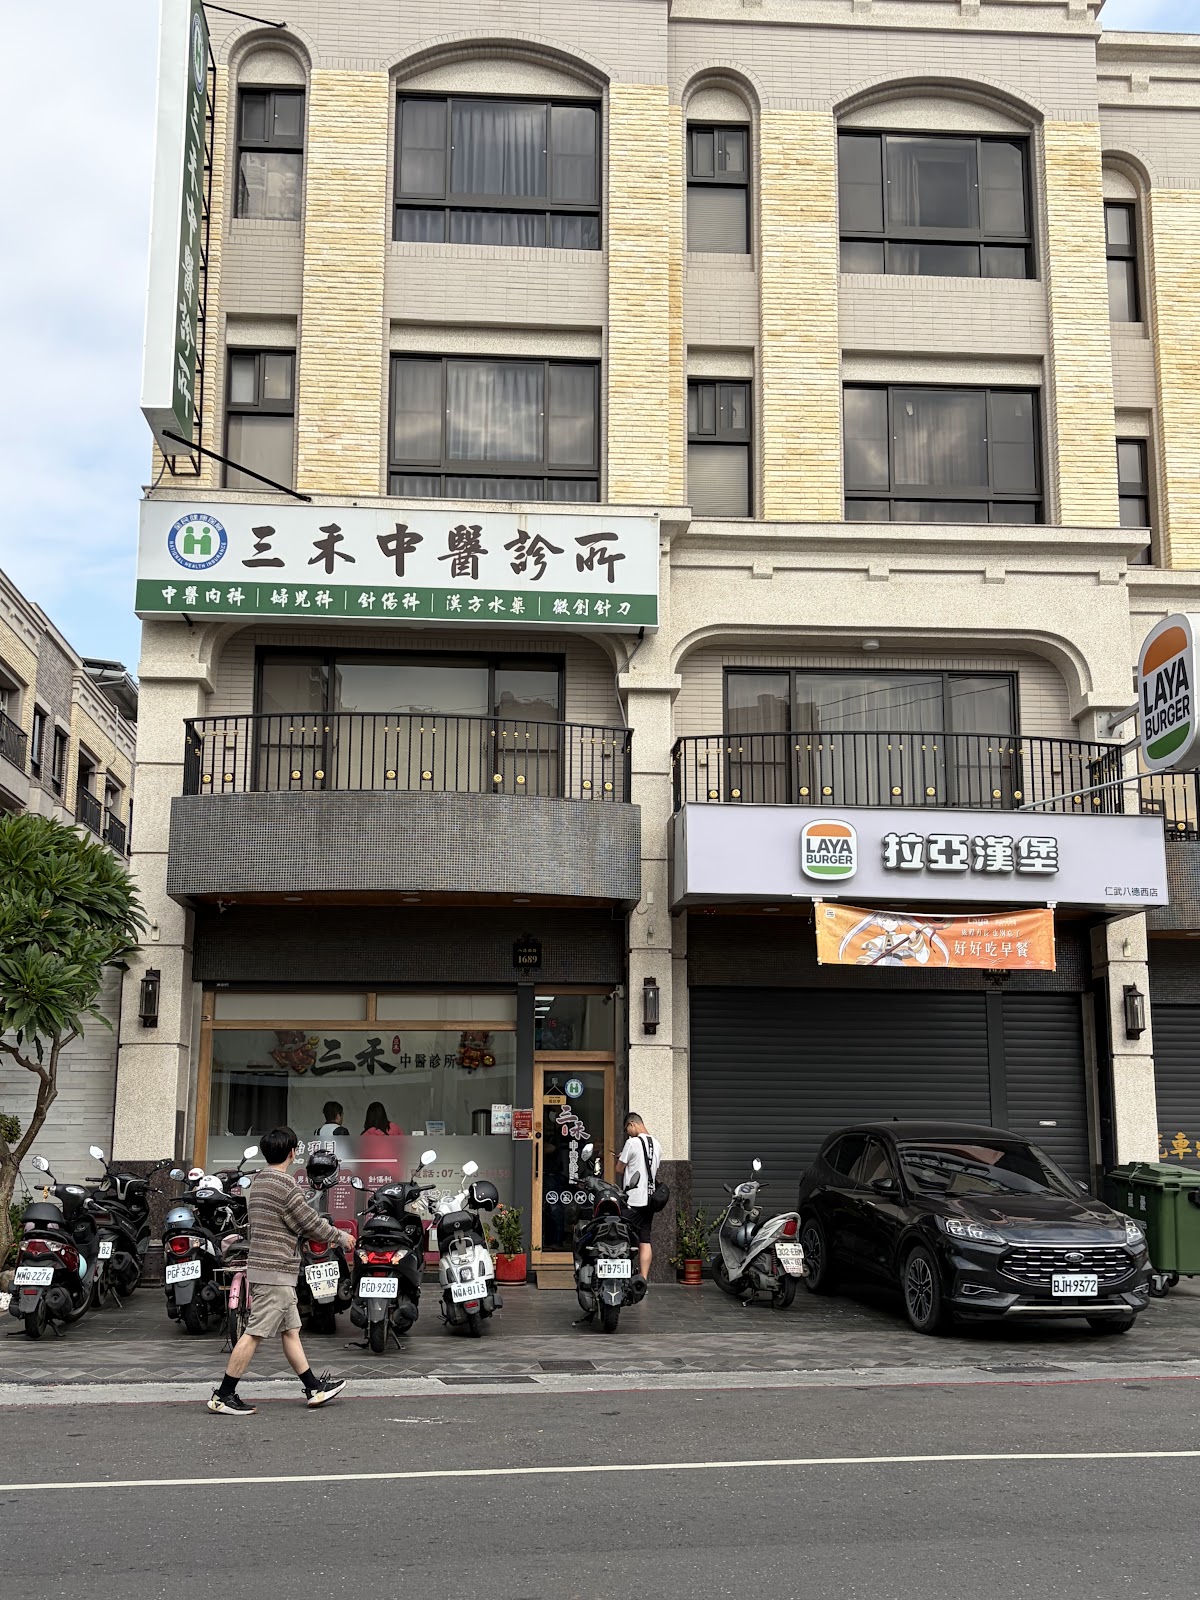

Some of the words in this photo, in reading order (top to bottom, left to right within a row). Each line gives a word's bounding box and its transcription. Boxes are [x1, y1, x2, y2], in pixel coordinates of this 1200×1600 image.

[241, 522, 626, 583] 三禾中醫診所
[552, 598, 632, 618] 微創針刀
[1143, 656, 1190, 717] LAYA
[1145, 694, 1191, 741] BURGER
[806, 838, 853, 855] LAYA
[881, 832, 1060, 875] 拉亞漢堡
[806, 855, 853, 865] BURGER
[1104, 886, 1158, 897] 仁武八德西店
[954, 940, 1028, 958] 好好吃早餐
[518, 955, 538, 964] 1689
[311, 1037, 398, 1076] 三禾
[400, 1053, 456, 1069] 中醫診所
[556, 1105, 591, 1140] 三禾
[167, 1264, 200, 1280] PGF-3296
[598, 1263, 629, 1274] MTB-7511
[360, 1282, 396, 1294] PGD-9203
[453, 1283, 486, 1298] NQA-8113
[1053, 1279, 1097, 1293] BJH-9372
